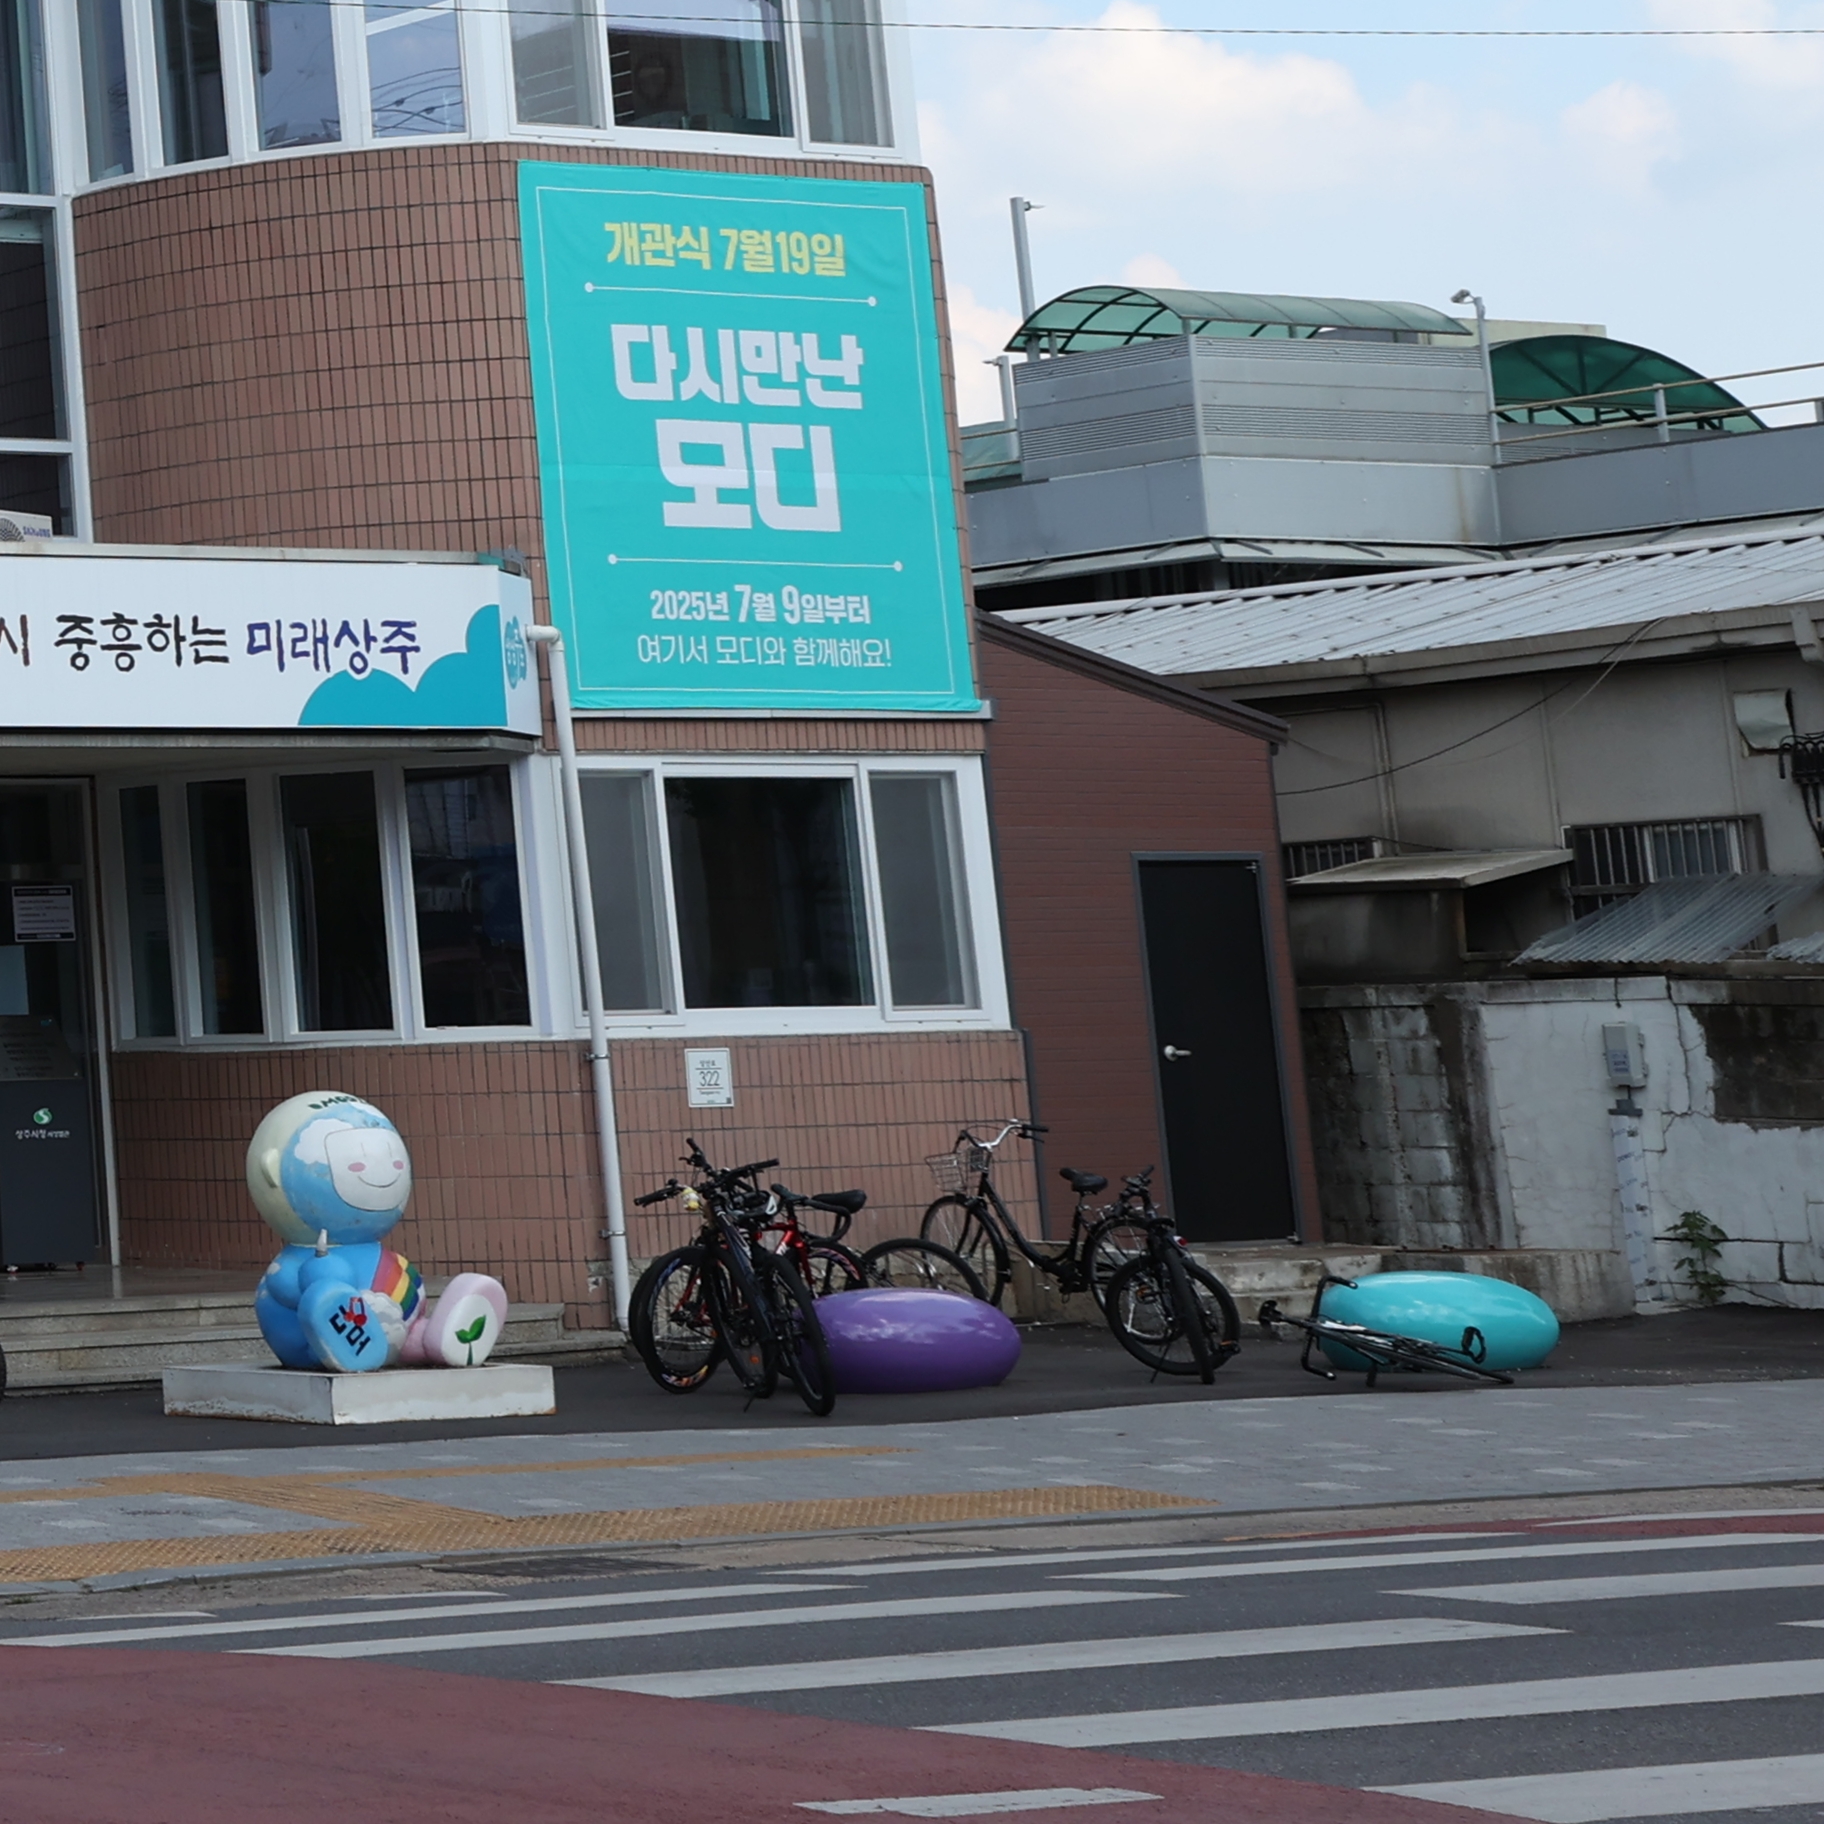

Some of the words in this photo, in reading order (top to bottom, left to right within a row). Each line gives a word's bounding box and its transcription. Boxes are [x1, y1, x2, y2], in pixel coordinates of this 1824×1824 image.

[604, 222, 711, 271] 개관식
[719, 229, 846, 277] 7월19일
[610, 323, 864, 410] 다시만난
[655, 419, 841, 532] 모디
[22, 526, 51, 538] SAMSUNG
[650, 590, 729, 622] 2025년
[734, 585, 776, 623] 7월
[782, 586, 870, 624] 9일부터
[54, 612, 229, 672] 중흥하는
[246, 618, 421, 675] 미래상주
[637, 634, 709, 666] 여기서
[716, 635, 786, 667] 모디와
[793, 636, 892, 669] 함께해요!
[699, 1070, 720, 1087] 322
